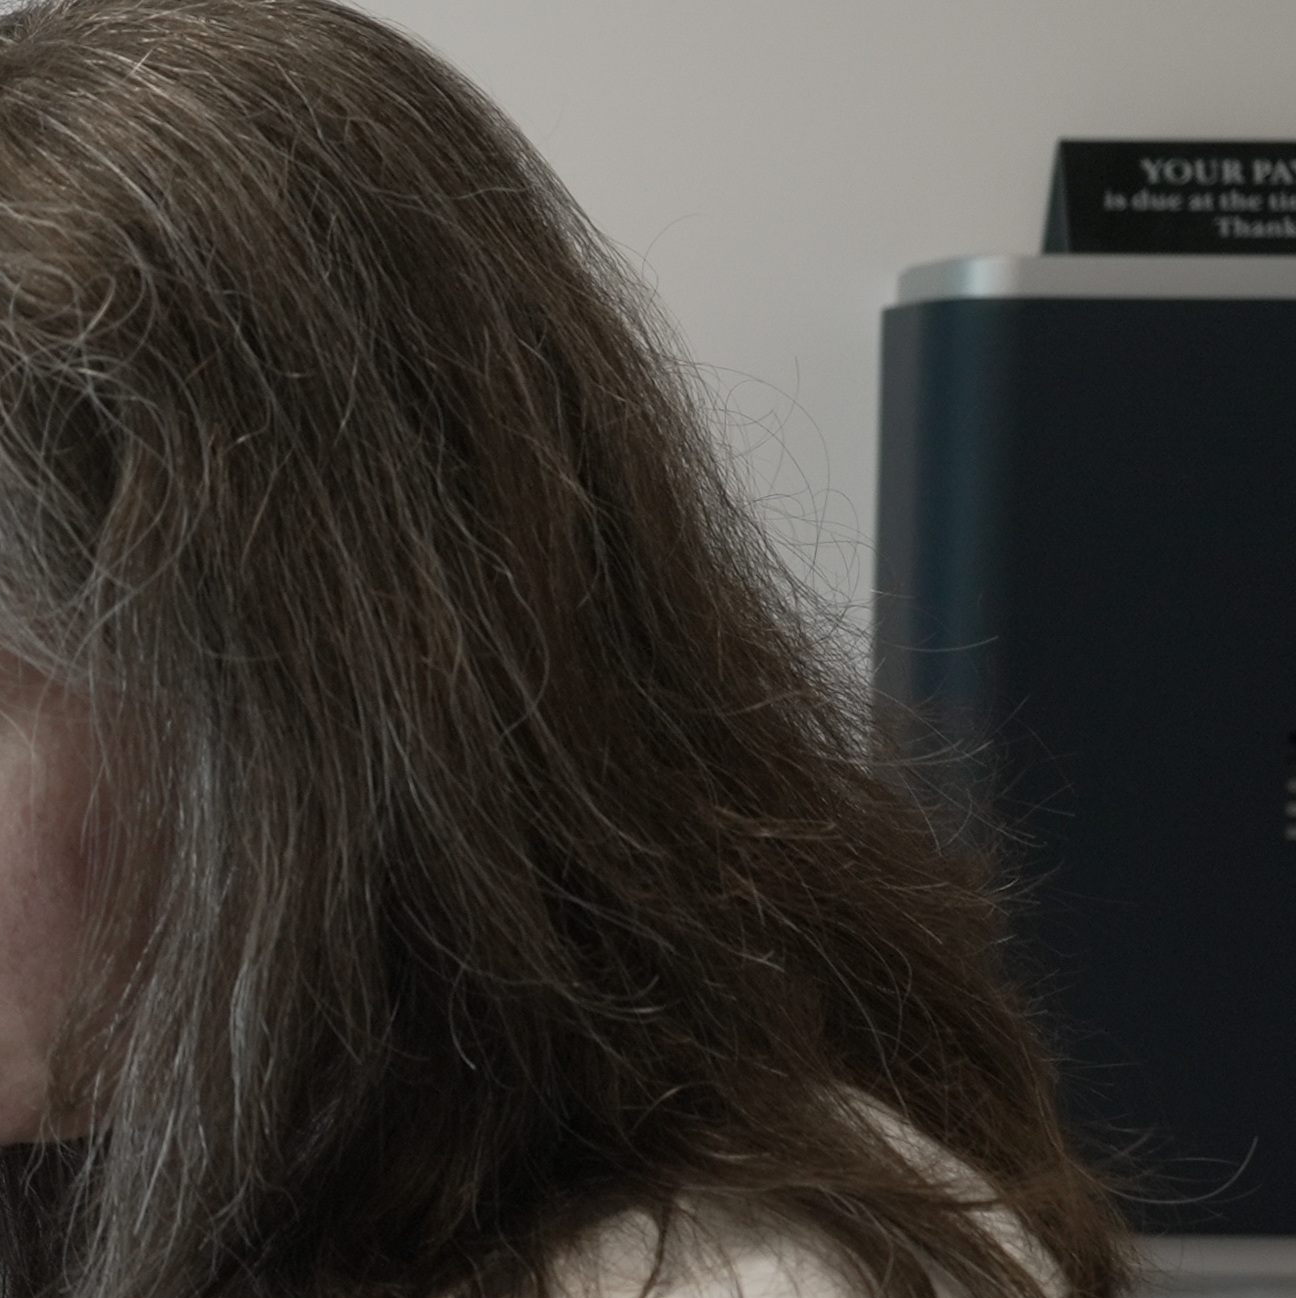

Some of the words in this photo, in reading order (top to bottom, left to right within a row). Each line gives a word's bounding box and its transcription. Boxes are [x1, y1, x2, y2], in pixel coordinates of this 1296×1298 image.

[1140, 158, 1244, 185] YOUR
[1252, 158, 1296, 185] PA
[1103, 189, 1127, 211] is
[1131, 189, 1182, 211] due
[1188, 193, 1214, 211] at
[1219, 189, 1262, 211] the
